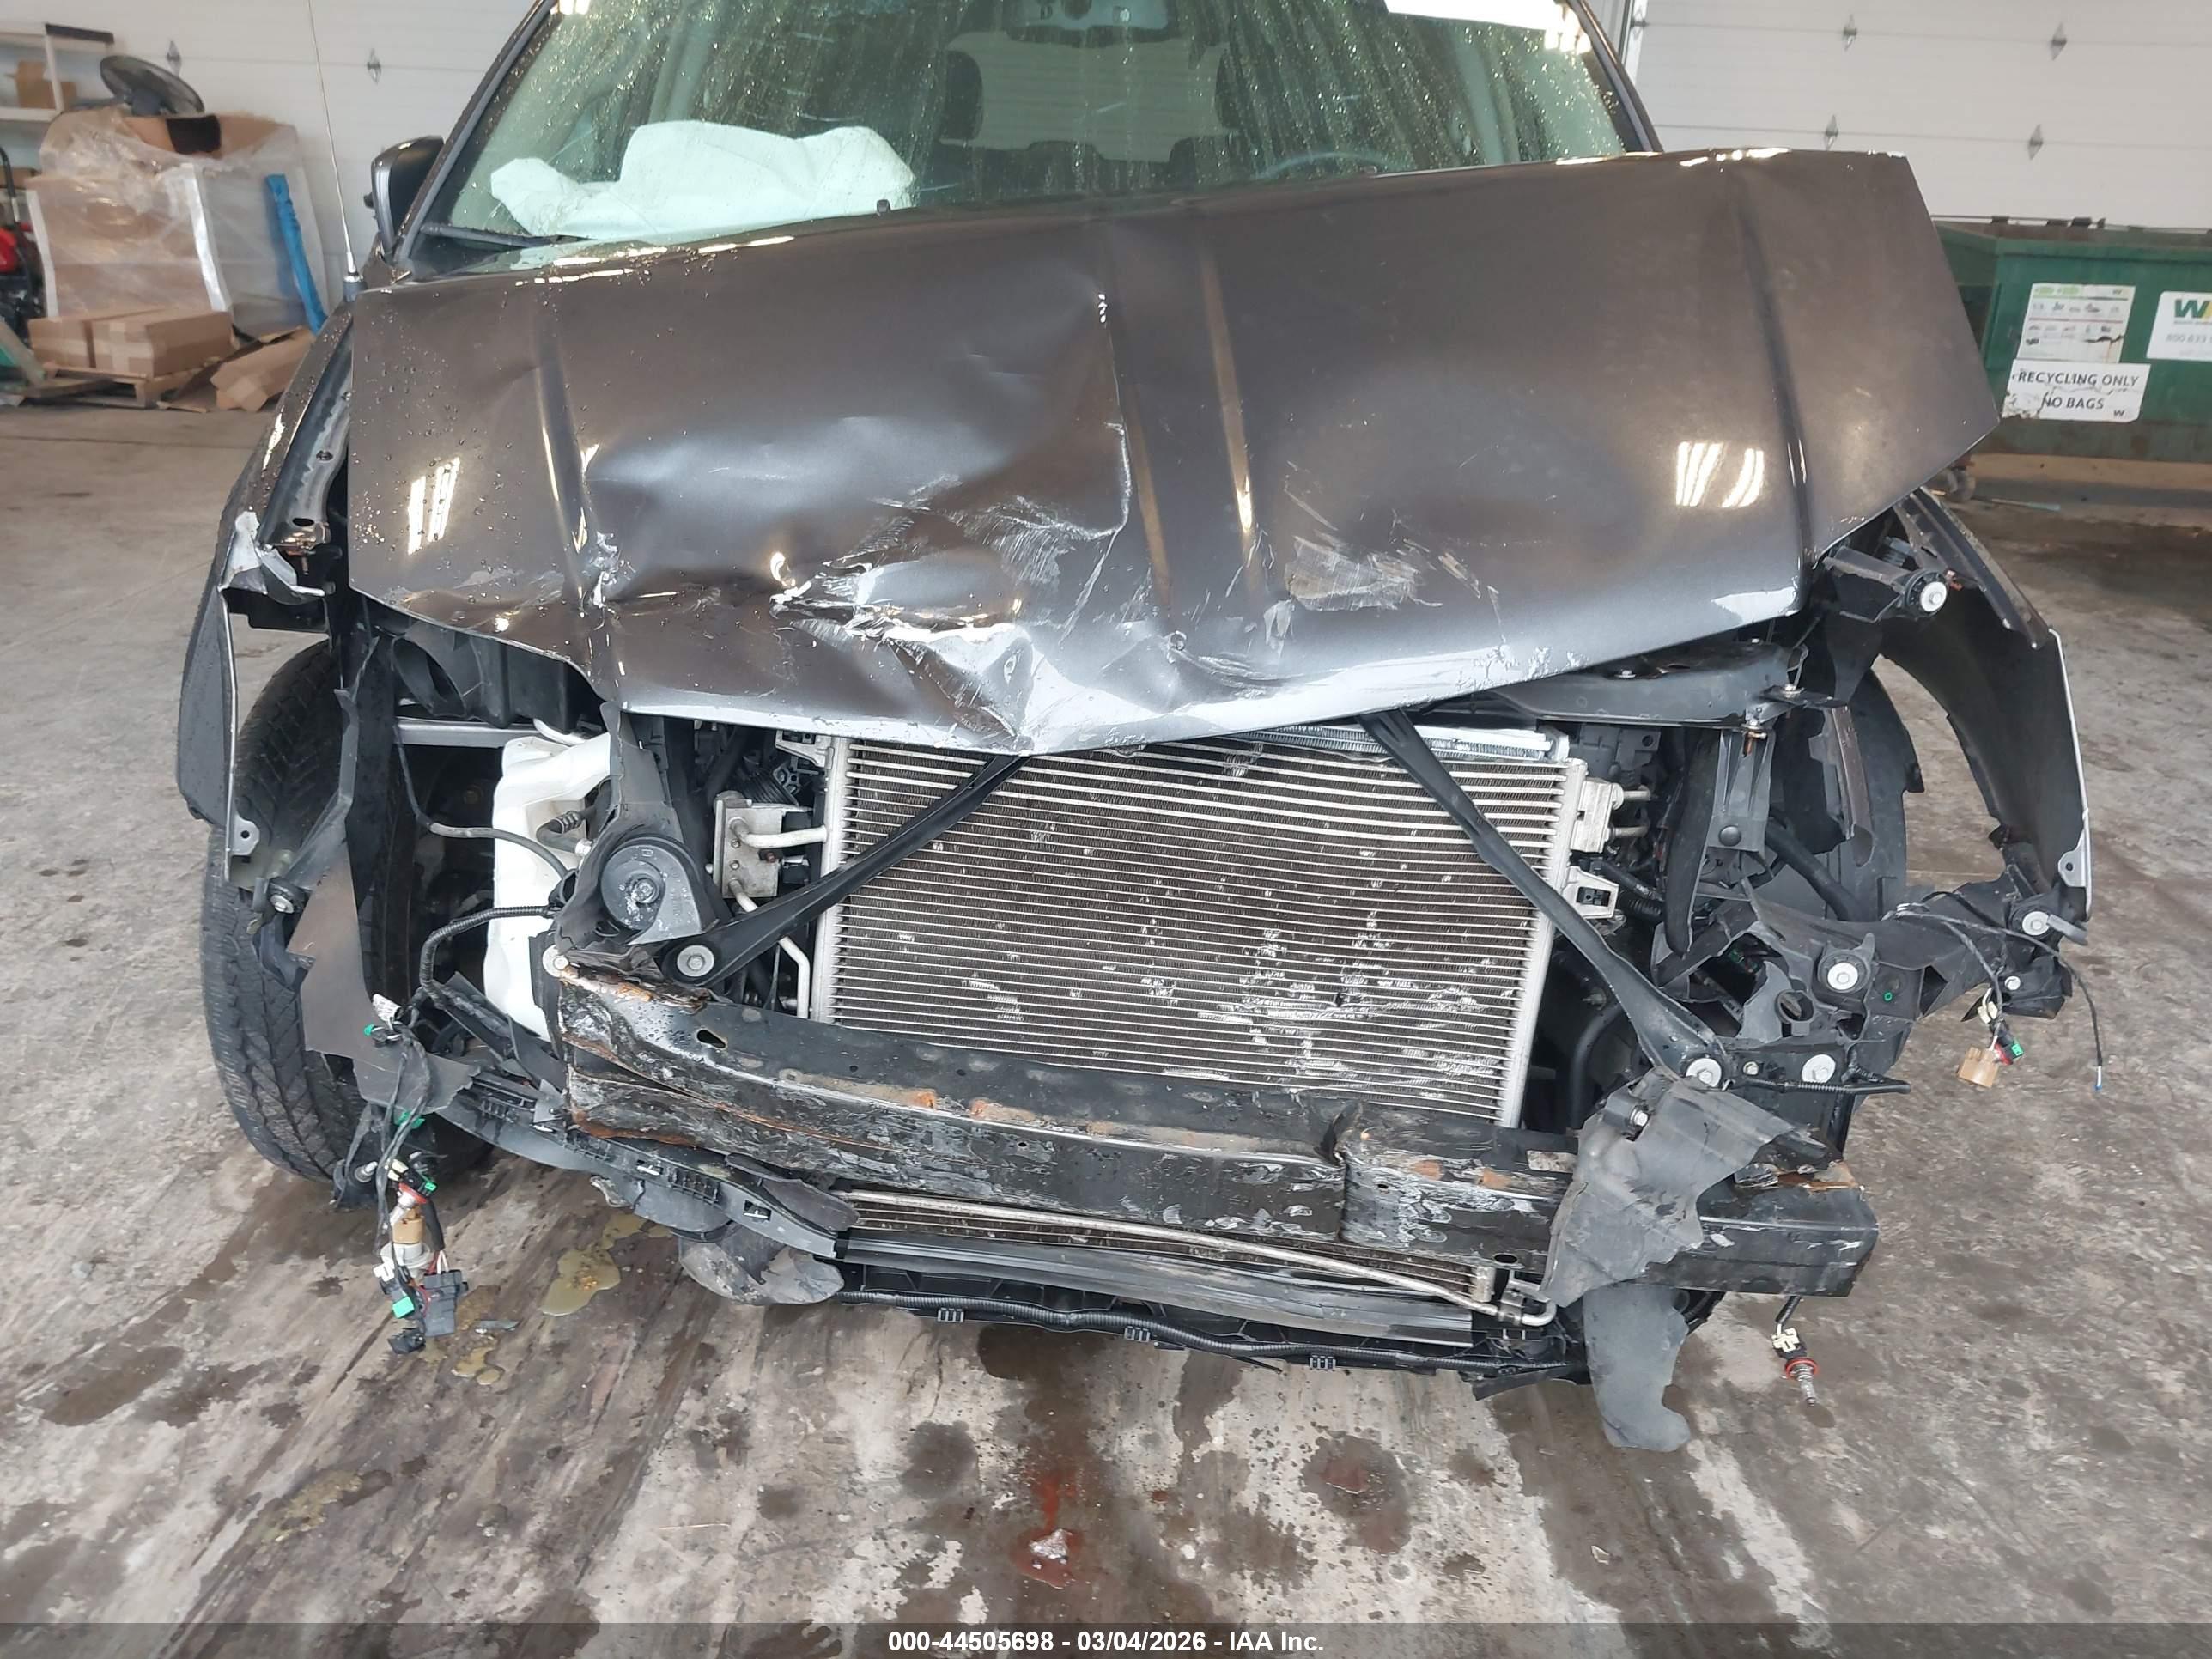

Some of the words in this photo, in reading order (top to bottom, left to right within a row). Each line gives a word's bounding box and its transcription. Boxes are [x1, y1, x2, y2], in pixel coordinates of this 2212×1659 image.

[2018, 371, 2098, 386] RECYCLING
[2101, 374, 2139, 386] ONLY
[2042, 396, 2063, 408] NO
[2066, 397, 2104, 410] BAGS
